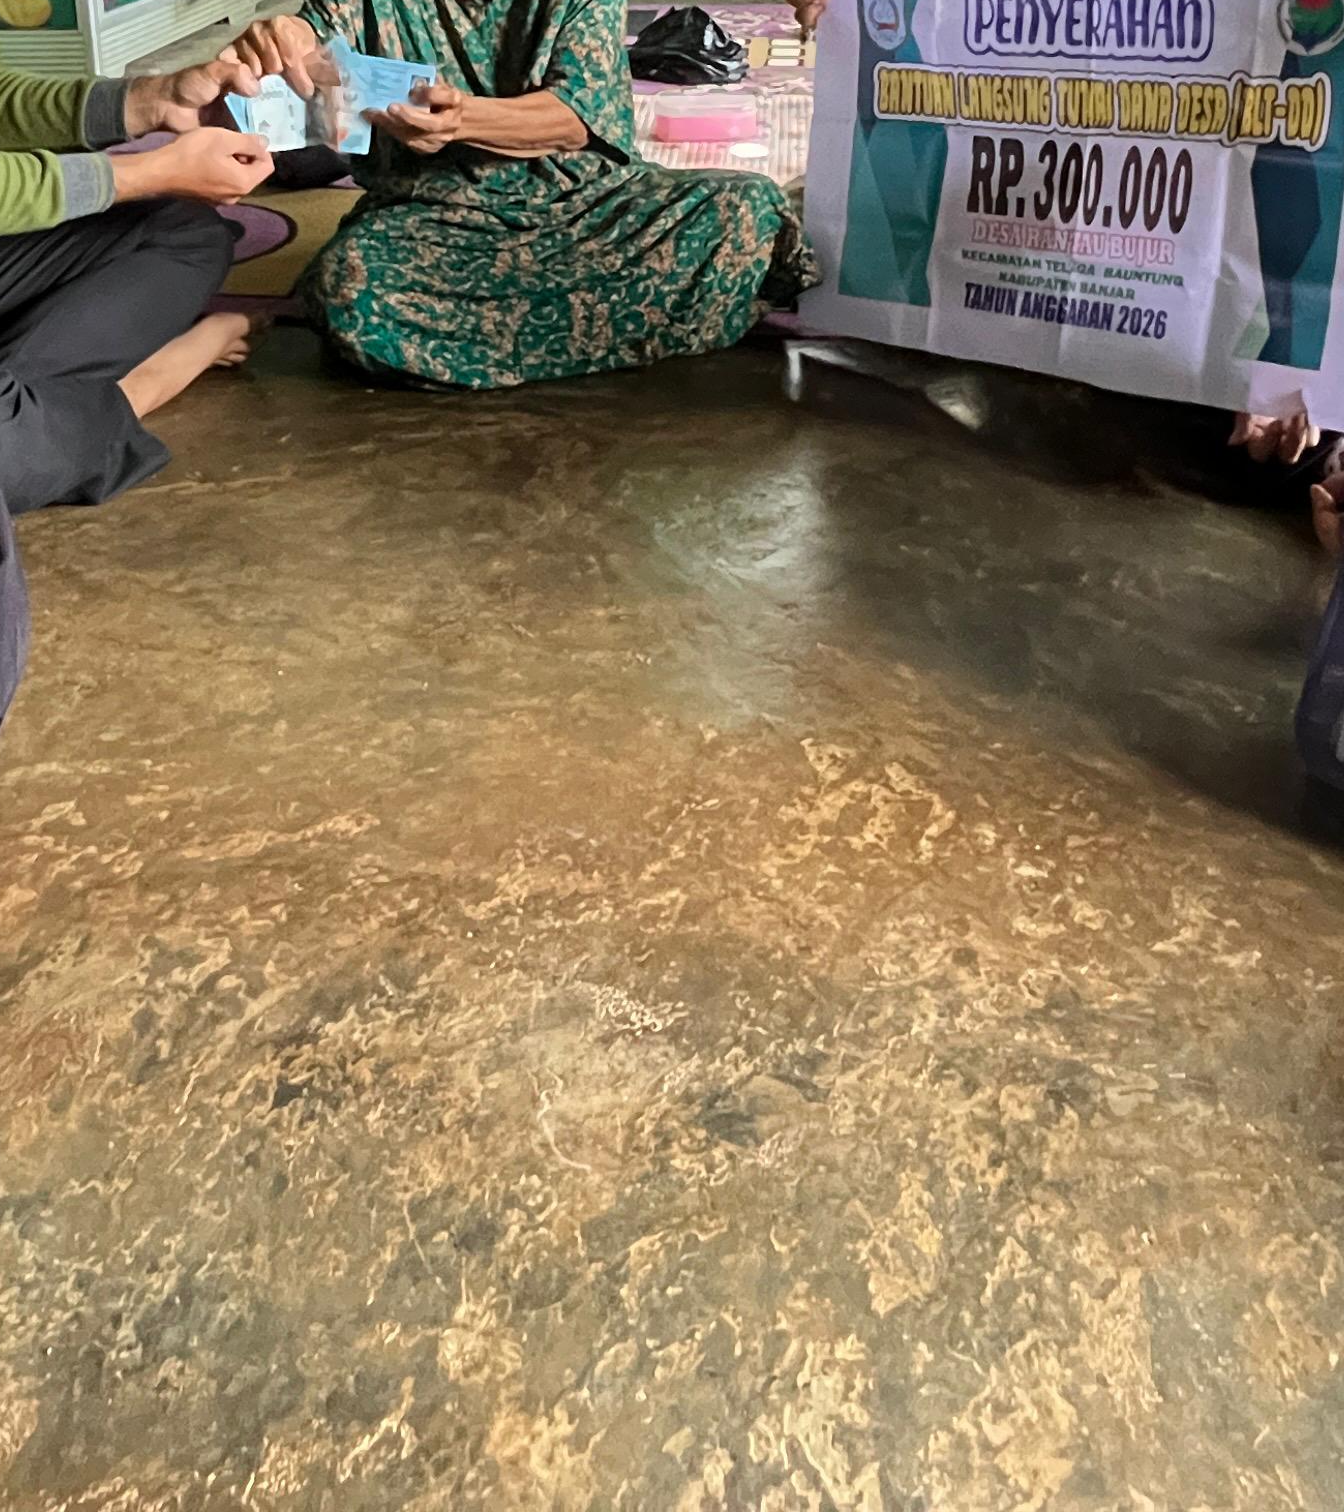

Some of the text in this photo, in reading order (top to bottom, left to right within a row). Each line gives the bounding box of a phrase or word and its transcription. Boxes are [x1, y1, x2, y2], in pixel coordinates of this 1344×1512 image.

[878, 67, 1326, 146] BANTUAN LANGSUNG TUNAI DANA DESA (BLT-DD)
[966, 135, 1193, 234] RP.300.000
[961, 248, 1042, 269] KECAMATAN
[1104, 266, 1184, 287] BAUNTUNG
[971, 219, 1175, 268] DESA RANTAU BUJUR
[964, 282, 1169, 340] TAHUN ANGGARAN 2026
[998, 271, 1136, 300] KABUPATEN BANJAR
